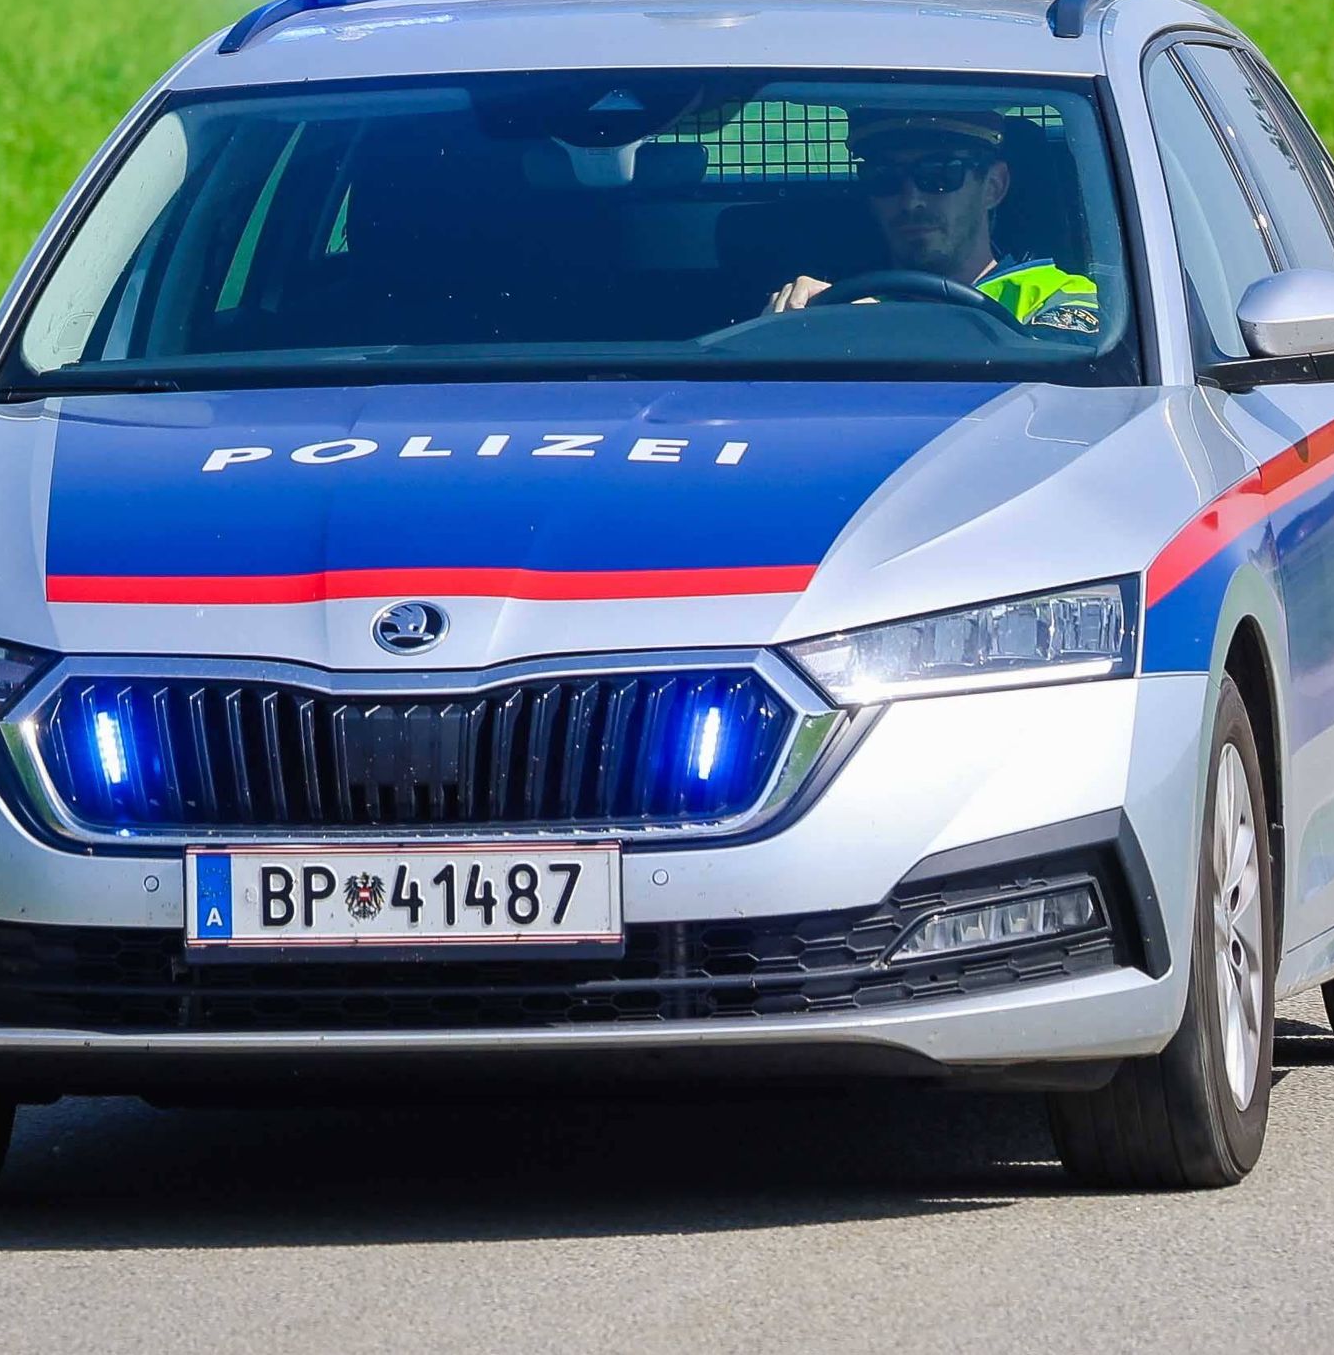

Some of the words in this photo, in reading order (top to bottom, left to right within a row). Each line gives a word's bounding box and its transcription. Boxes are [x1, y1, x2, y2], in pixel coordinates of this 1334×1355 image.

[202, 434, 750, 472] POLIZEI
[260, 865, 336, 927] BP
[390, 863, 584, 925] 41487
[206, 907, 223, 927] A
